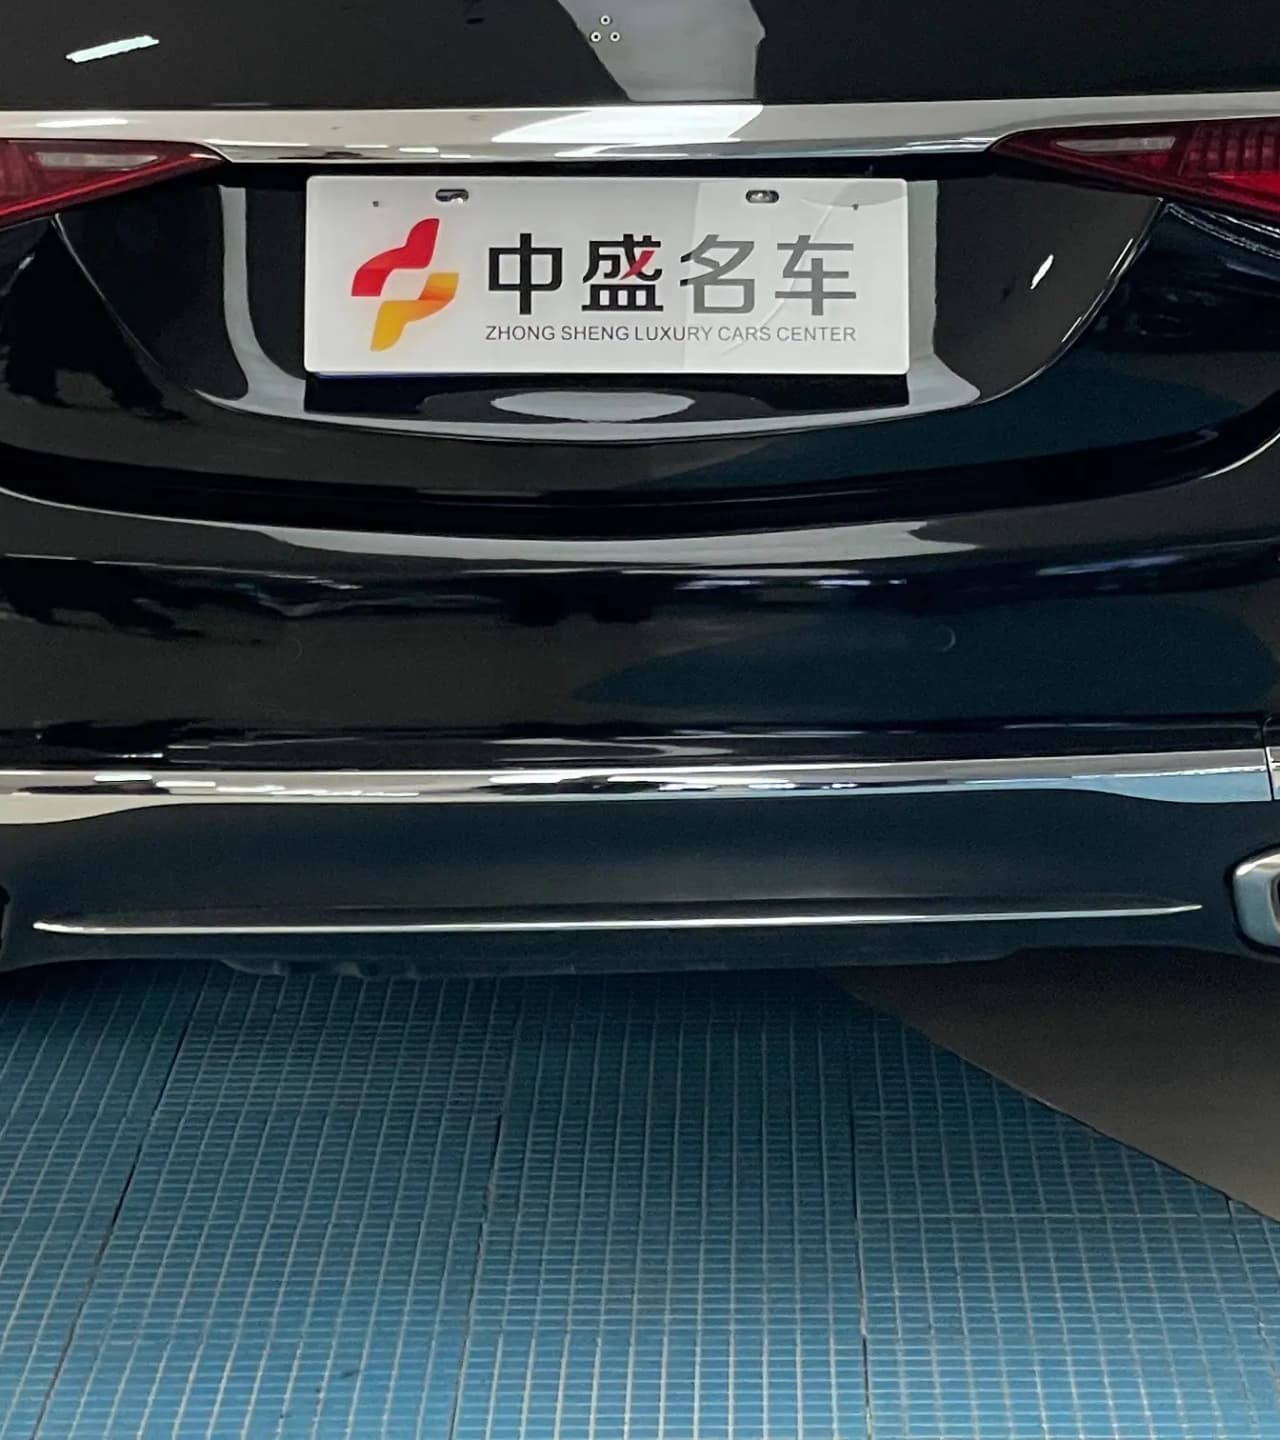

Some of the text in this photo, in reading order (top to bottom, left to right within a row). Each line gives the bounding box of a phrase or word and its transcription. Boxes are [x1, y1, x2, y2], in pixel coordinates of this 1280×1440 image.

[487, 232, 858, 317] 中盛名车
[484, 324, 858, 343] ZHONG SHENG LUXURY CARS CENTER
